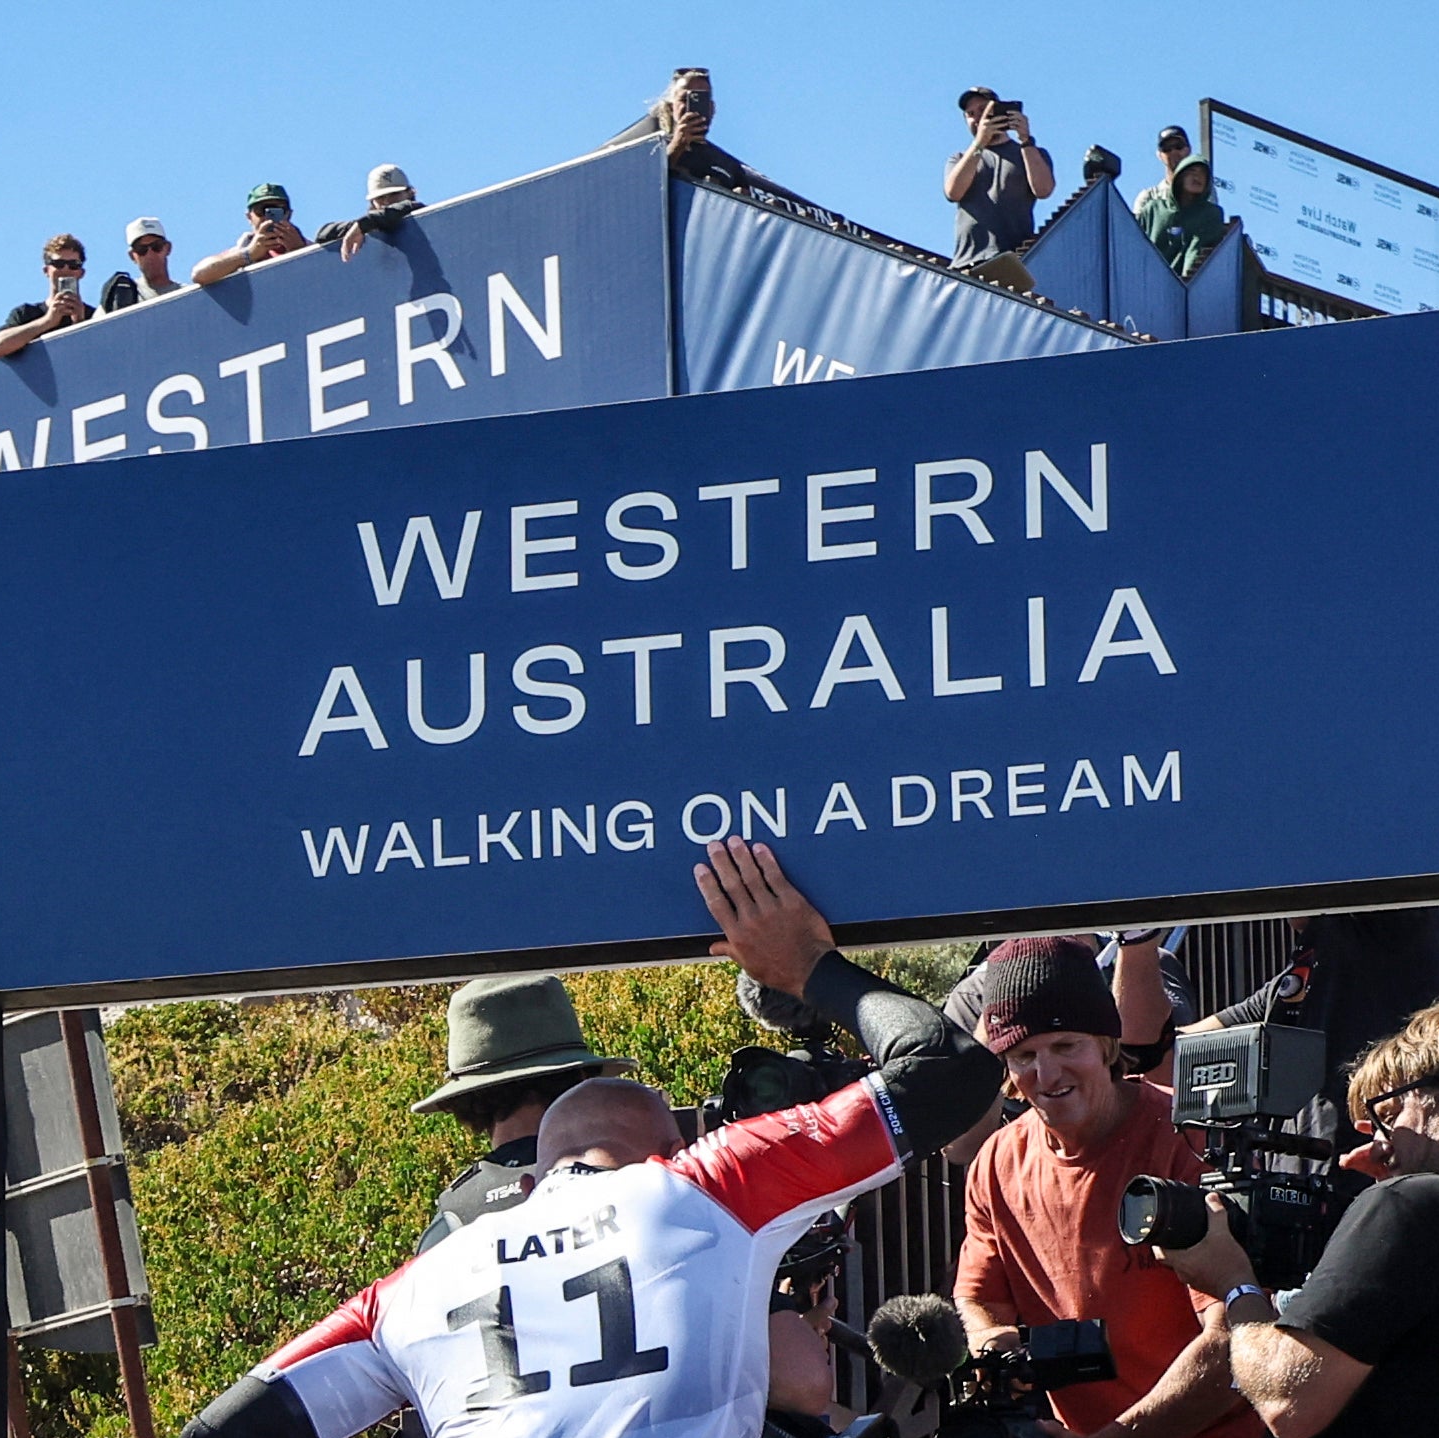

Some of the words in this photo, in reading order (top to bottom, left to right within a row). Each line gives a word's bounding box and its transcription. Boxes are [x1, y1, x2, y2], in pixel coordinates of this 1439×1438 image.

[358, 443, 1109, 606] WESTERN
[299, 588, 1176, 756] AUSTRALIA
[302, 801, 655, 877] WALKING
[682, 788, 786, 846] ON
[815, 782, 867, 834] A
[892, 750, 1181, 827] DREAM
[1191, 1061, 1237, 1087] RED
[471, 1204, 621, 1274] LATER
[447, 1256, 670, 1412] 11
